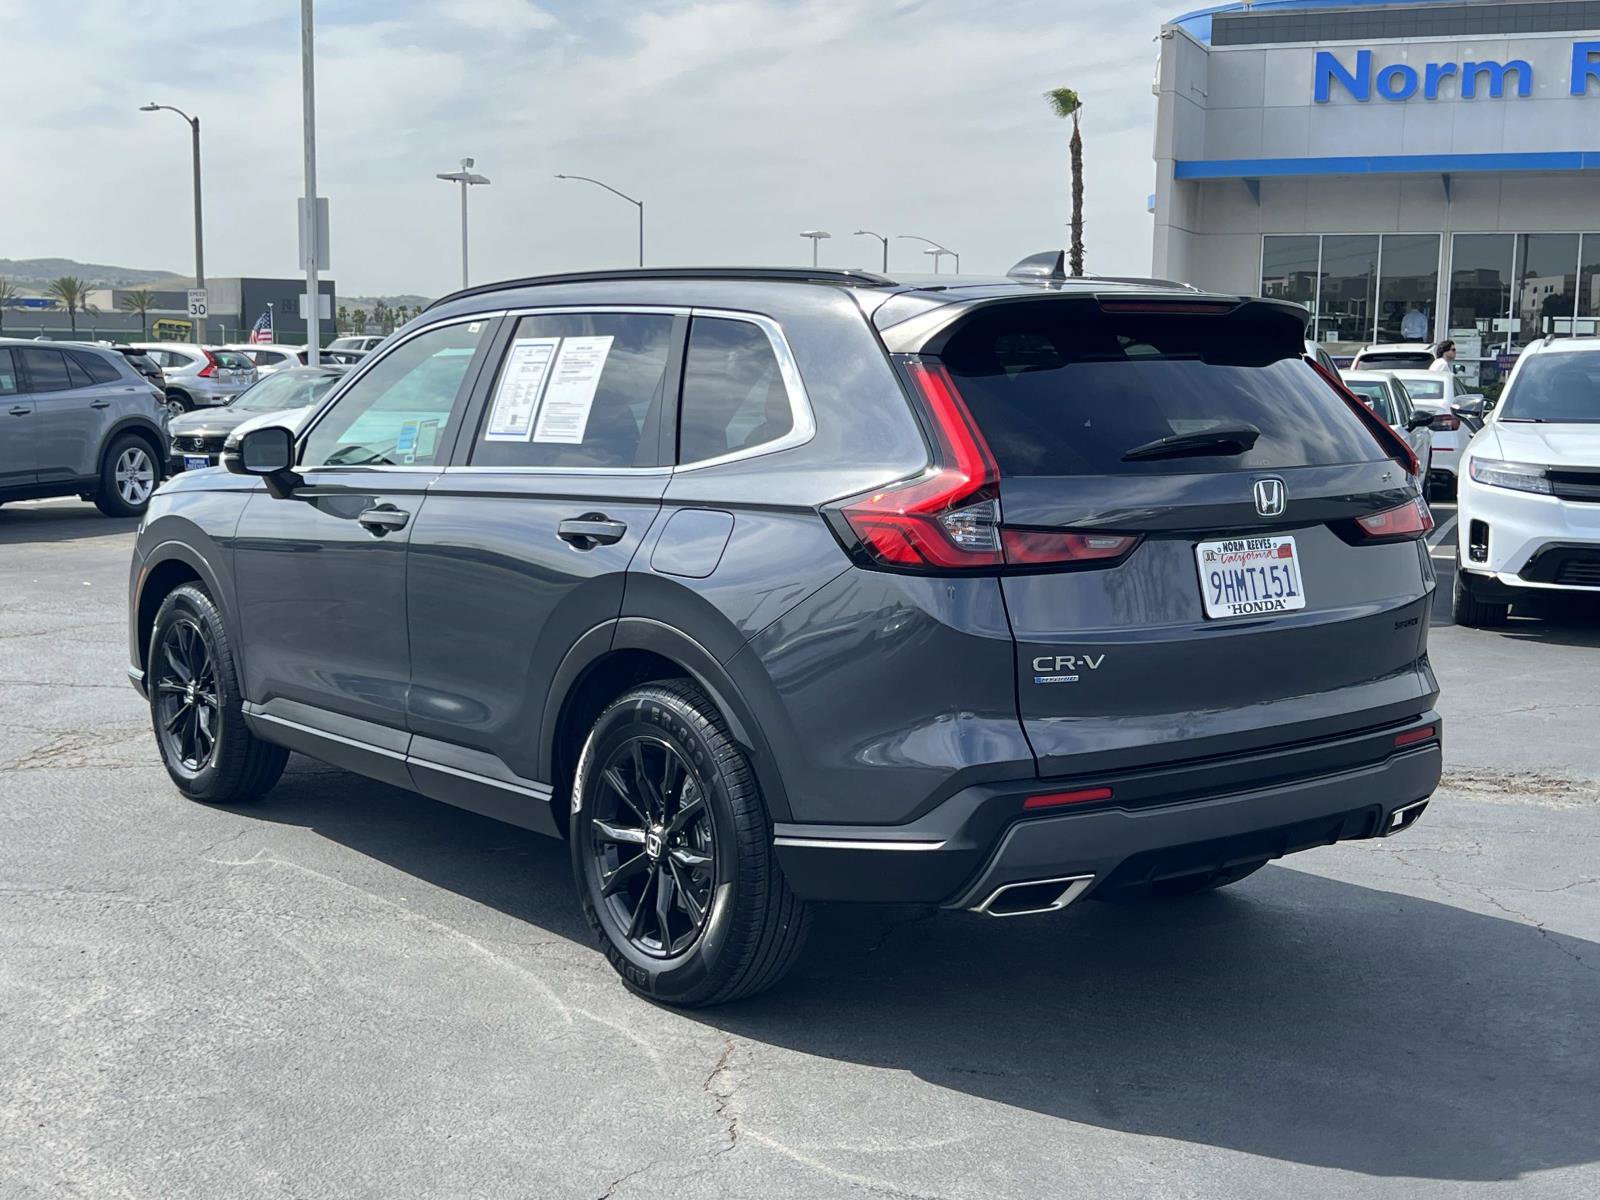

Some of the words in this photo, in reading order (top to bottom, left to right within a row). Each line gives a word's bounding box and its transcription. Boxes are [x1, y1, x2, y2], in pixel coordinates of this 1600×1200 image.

[1313, 49, 1533, 103] Norm
[190, 303, 206, 315] 30
[158, 322, 192, 333] BEST
[159, 331, 188, 341] BUY
[1222, 542, 1246, 553] NORM
[1247, 539, 1272, 550] REEVES
[1220, 549, 1273, 567] California
[1210, 564, 1297, 605] 9HMT151
[1032, 654, 1105, 672] CR-V
